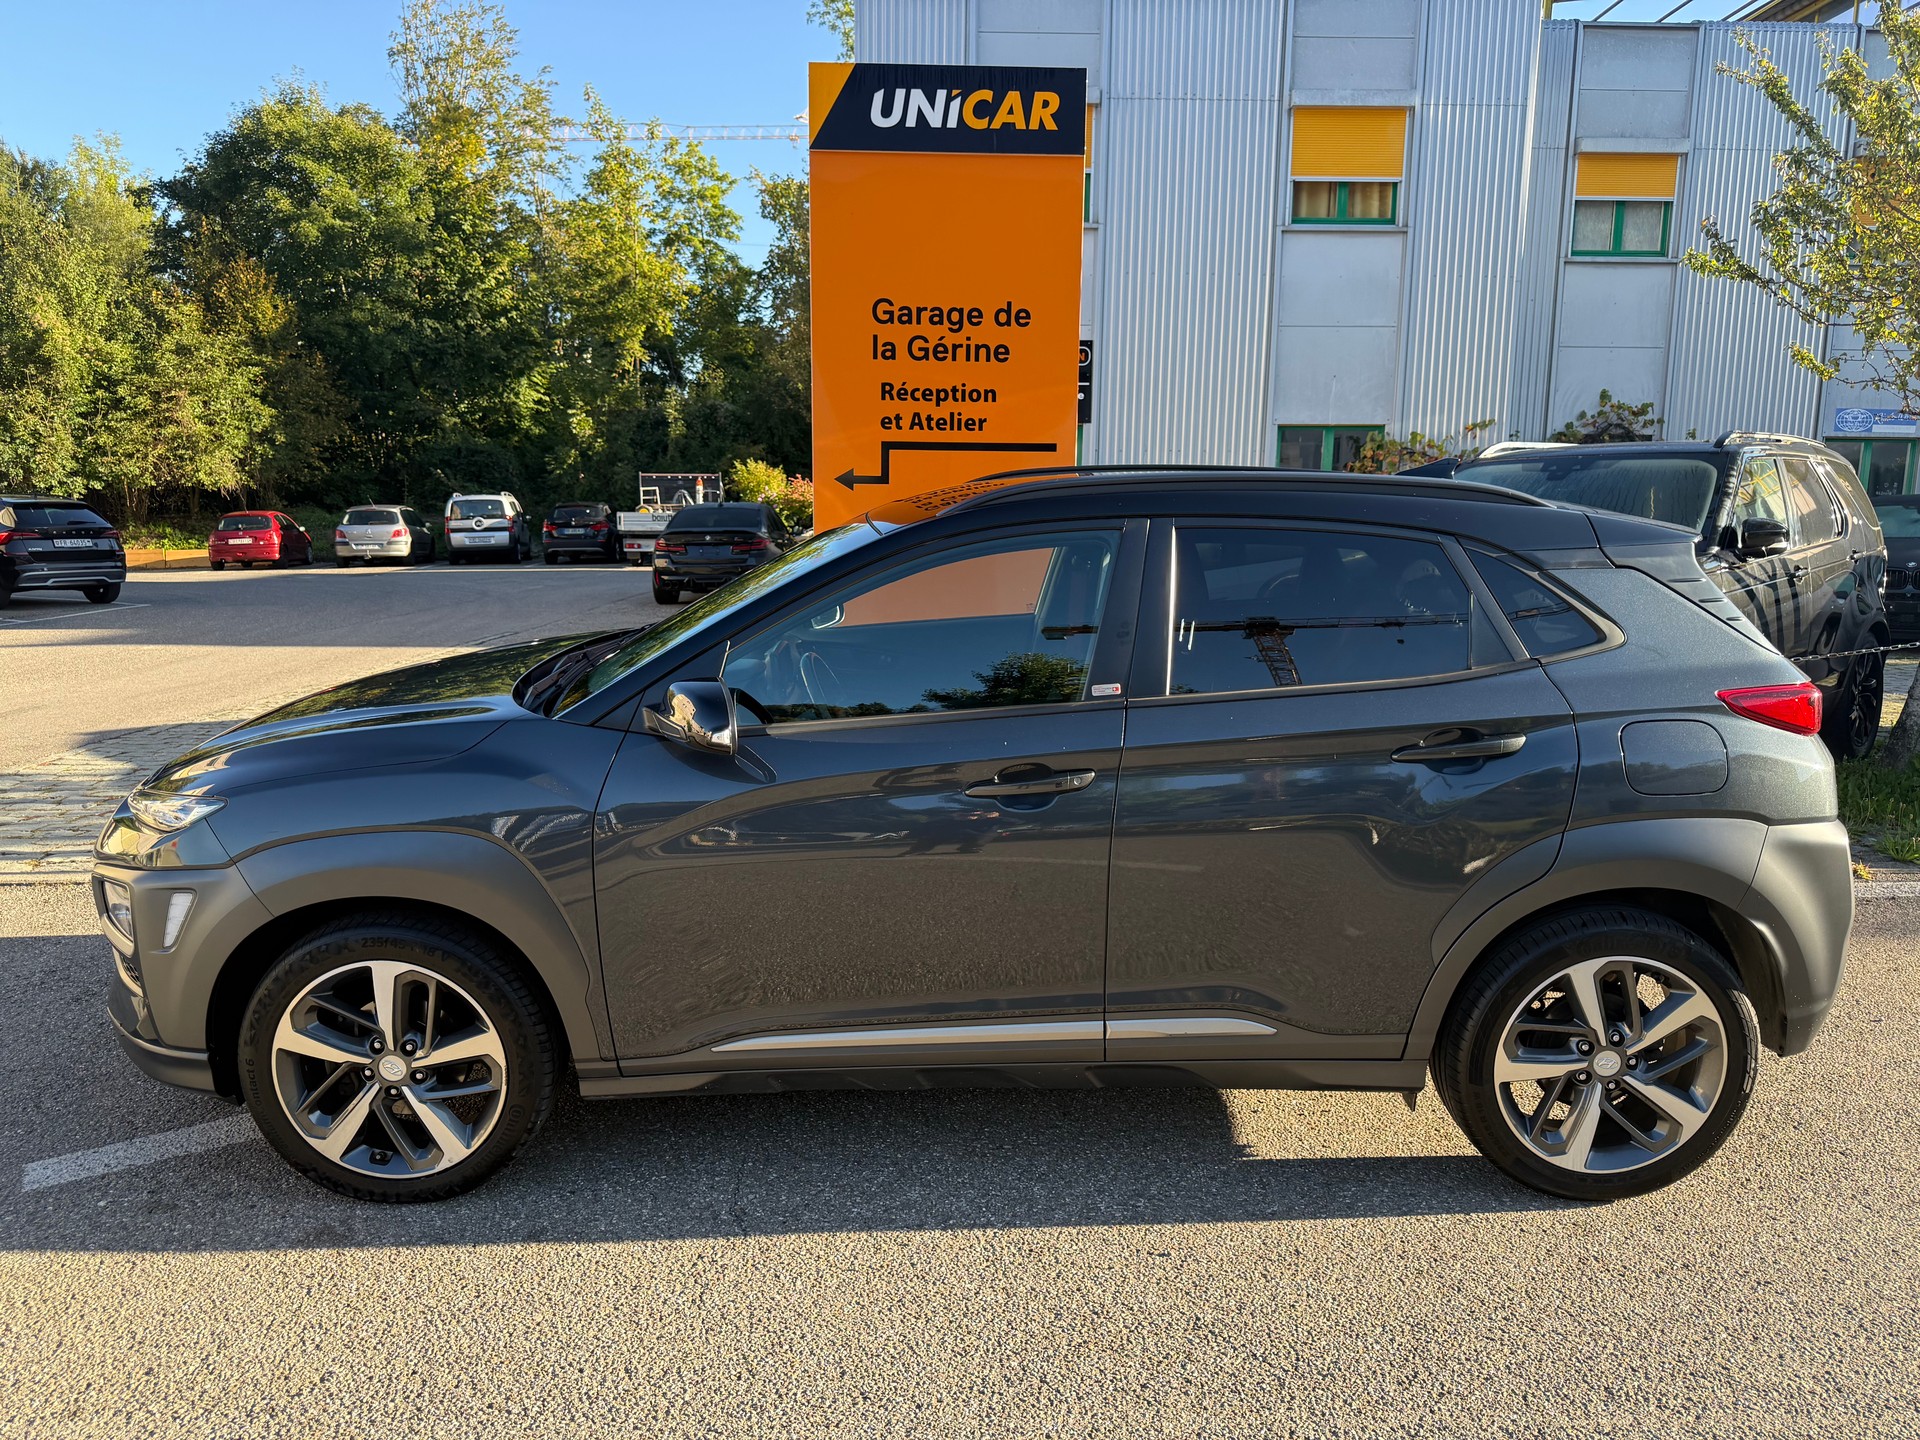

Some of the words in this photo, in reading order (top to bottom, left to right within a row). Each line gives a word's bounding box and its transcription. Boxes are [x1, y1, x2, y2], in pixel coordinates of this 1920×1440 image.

[871, 297, 984, 333] Garage
[993, 300, 1032, 328] de
[872, 334, 897, 361] la
[907, 334, 1010, 363] Gérine
[880, 381, 997, 408] Réception
[880, 413, 903, 431] et
[908, 411, 987, 432] Atelier
